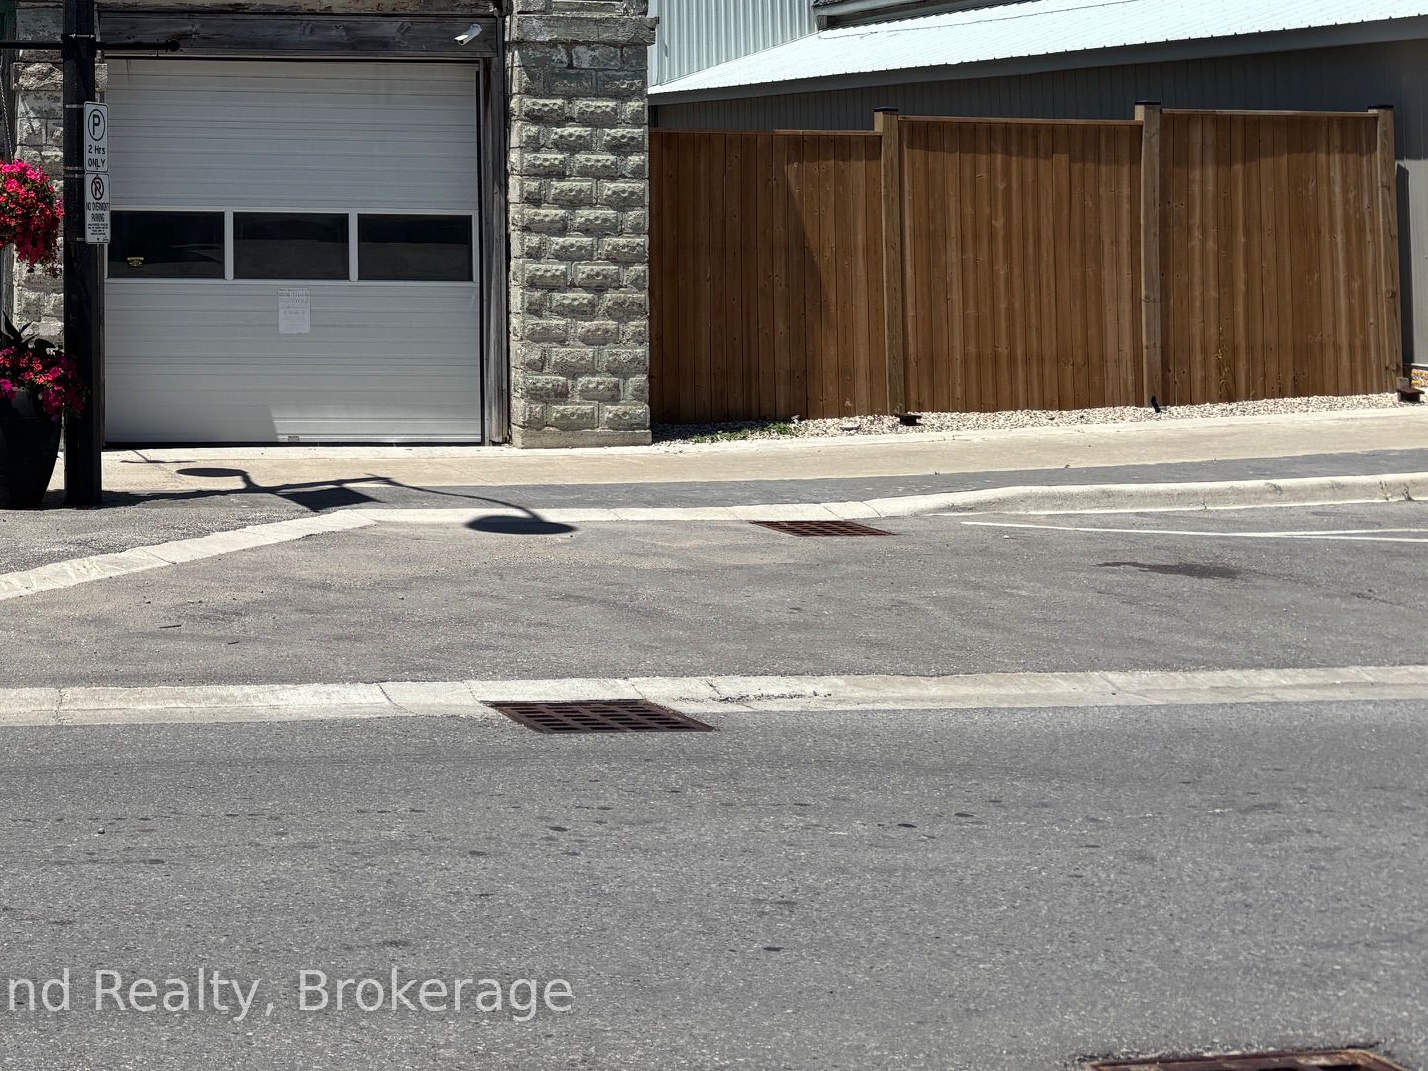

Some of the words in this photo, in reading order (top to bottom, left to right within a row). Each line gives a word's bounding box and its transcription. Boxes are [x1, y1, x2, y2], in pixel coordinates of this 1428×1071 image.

[88, 145, 93, 154] 2
[94, 145, 106, 155] Hrs
[88, 158, 105, 168] ONLY
